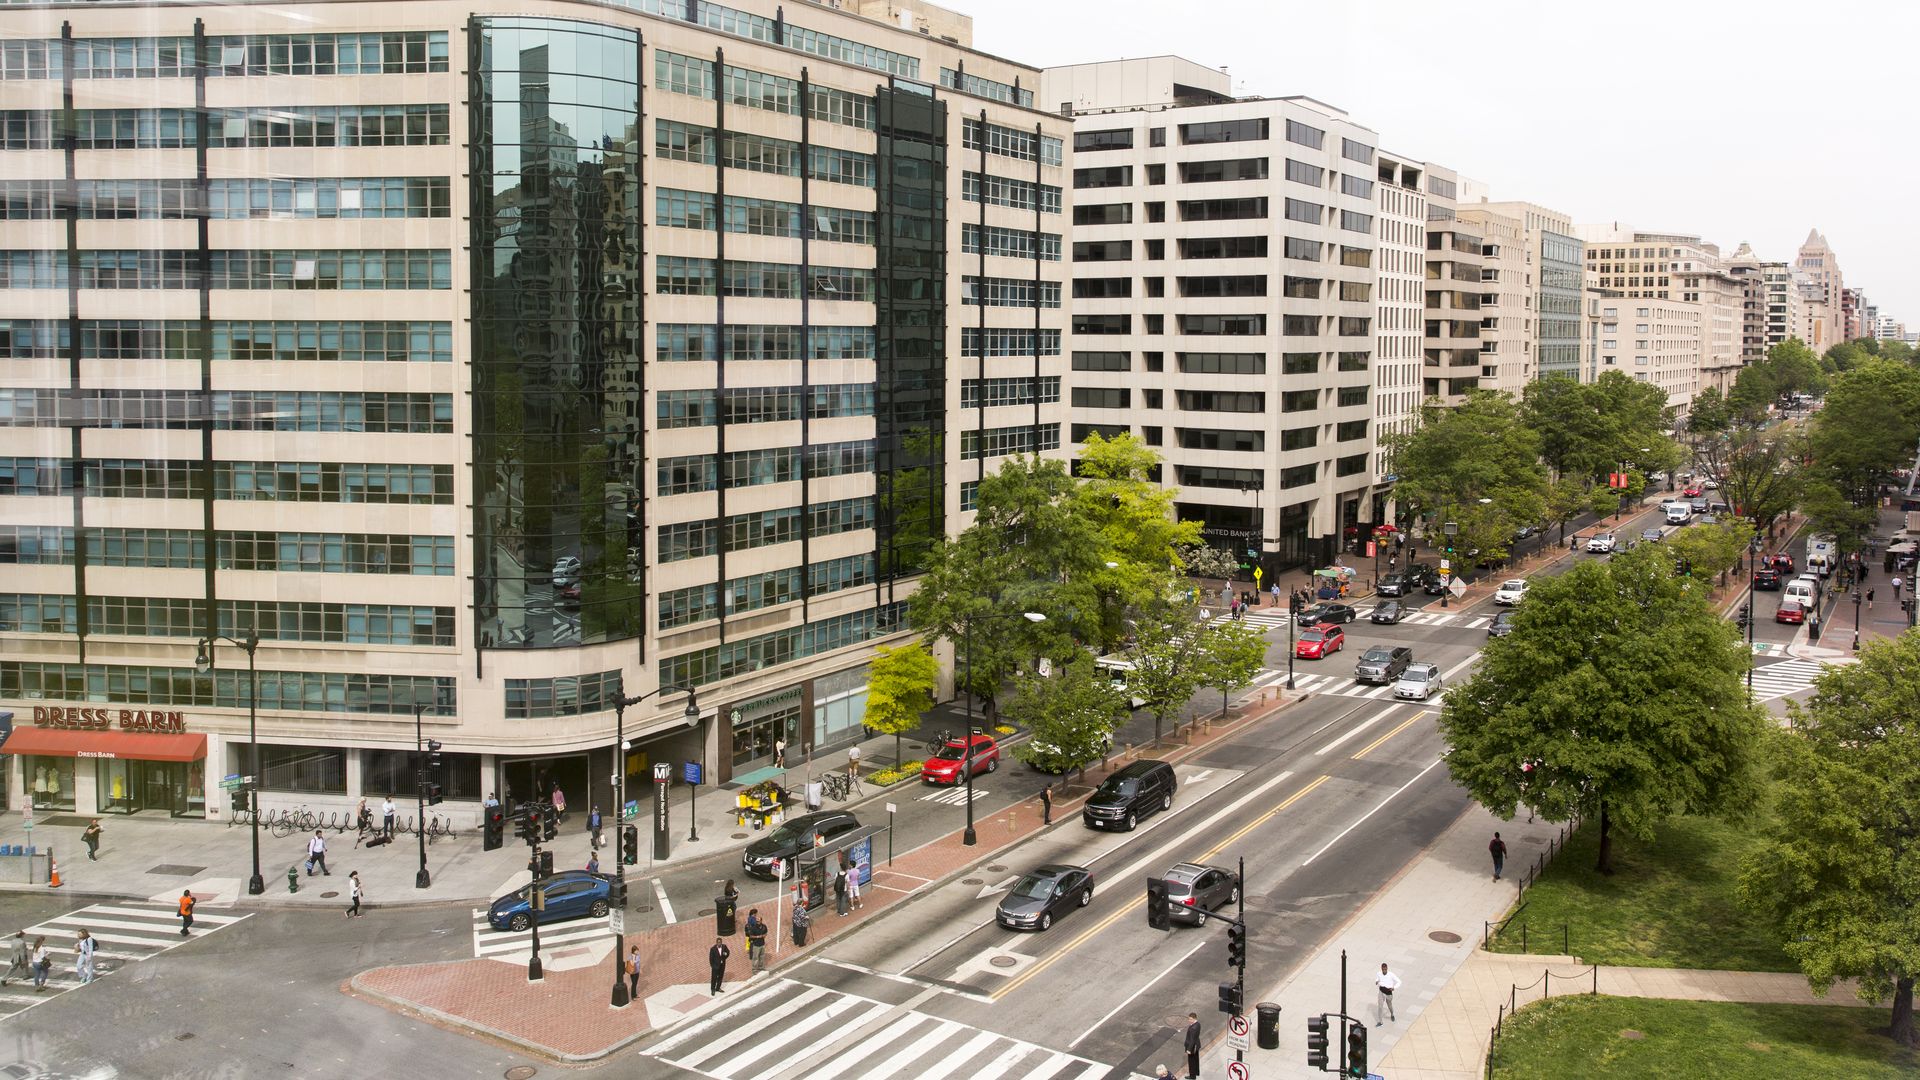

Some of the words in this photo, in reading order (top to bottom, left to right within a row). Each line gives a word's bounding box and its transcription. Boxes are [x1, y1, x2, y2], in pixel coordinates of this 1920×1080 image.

[1204, 528, 1229, 536] UNITED
[1230, 529, 1250, 538] BANK
[33, 706, 110, 728] DRESS
[119, 709, 185, 732] BARN
[654, 767, 666, 779] M
